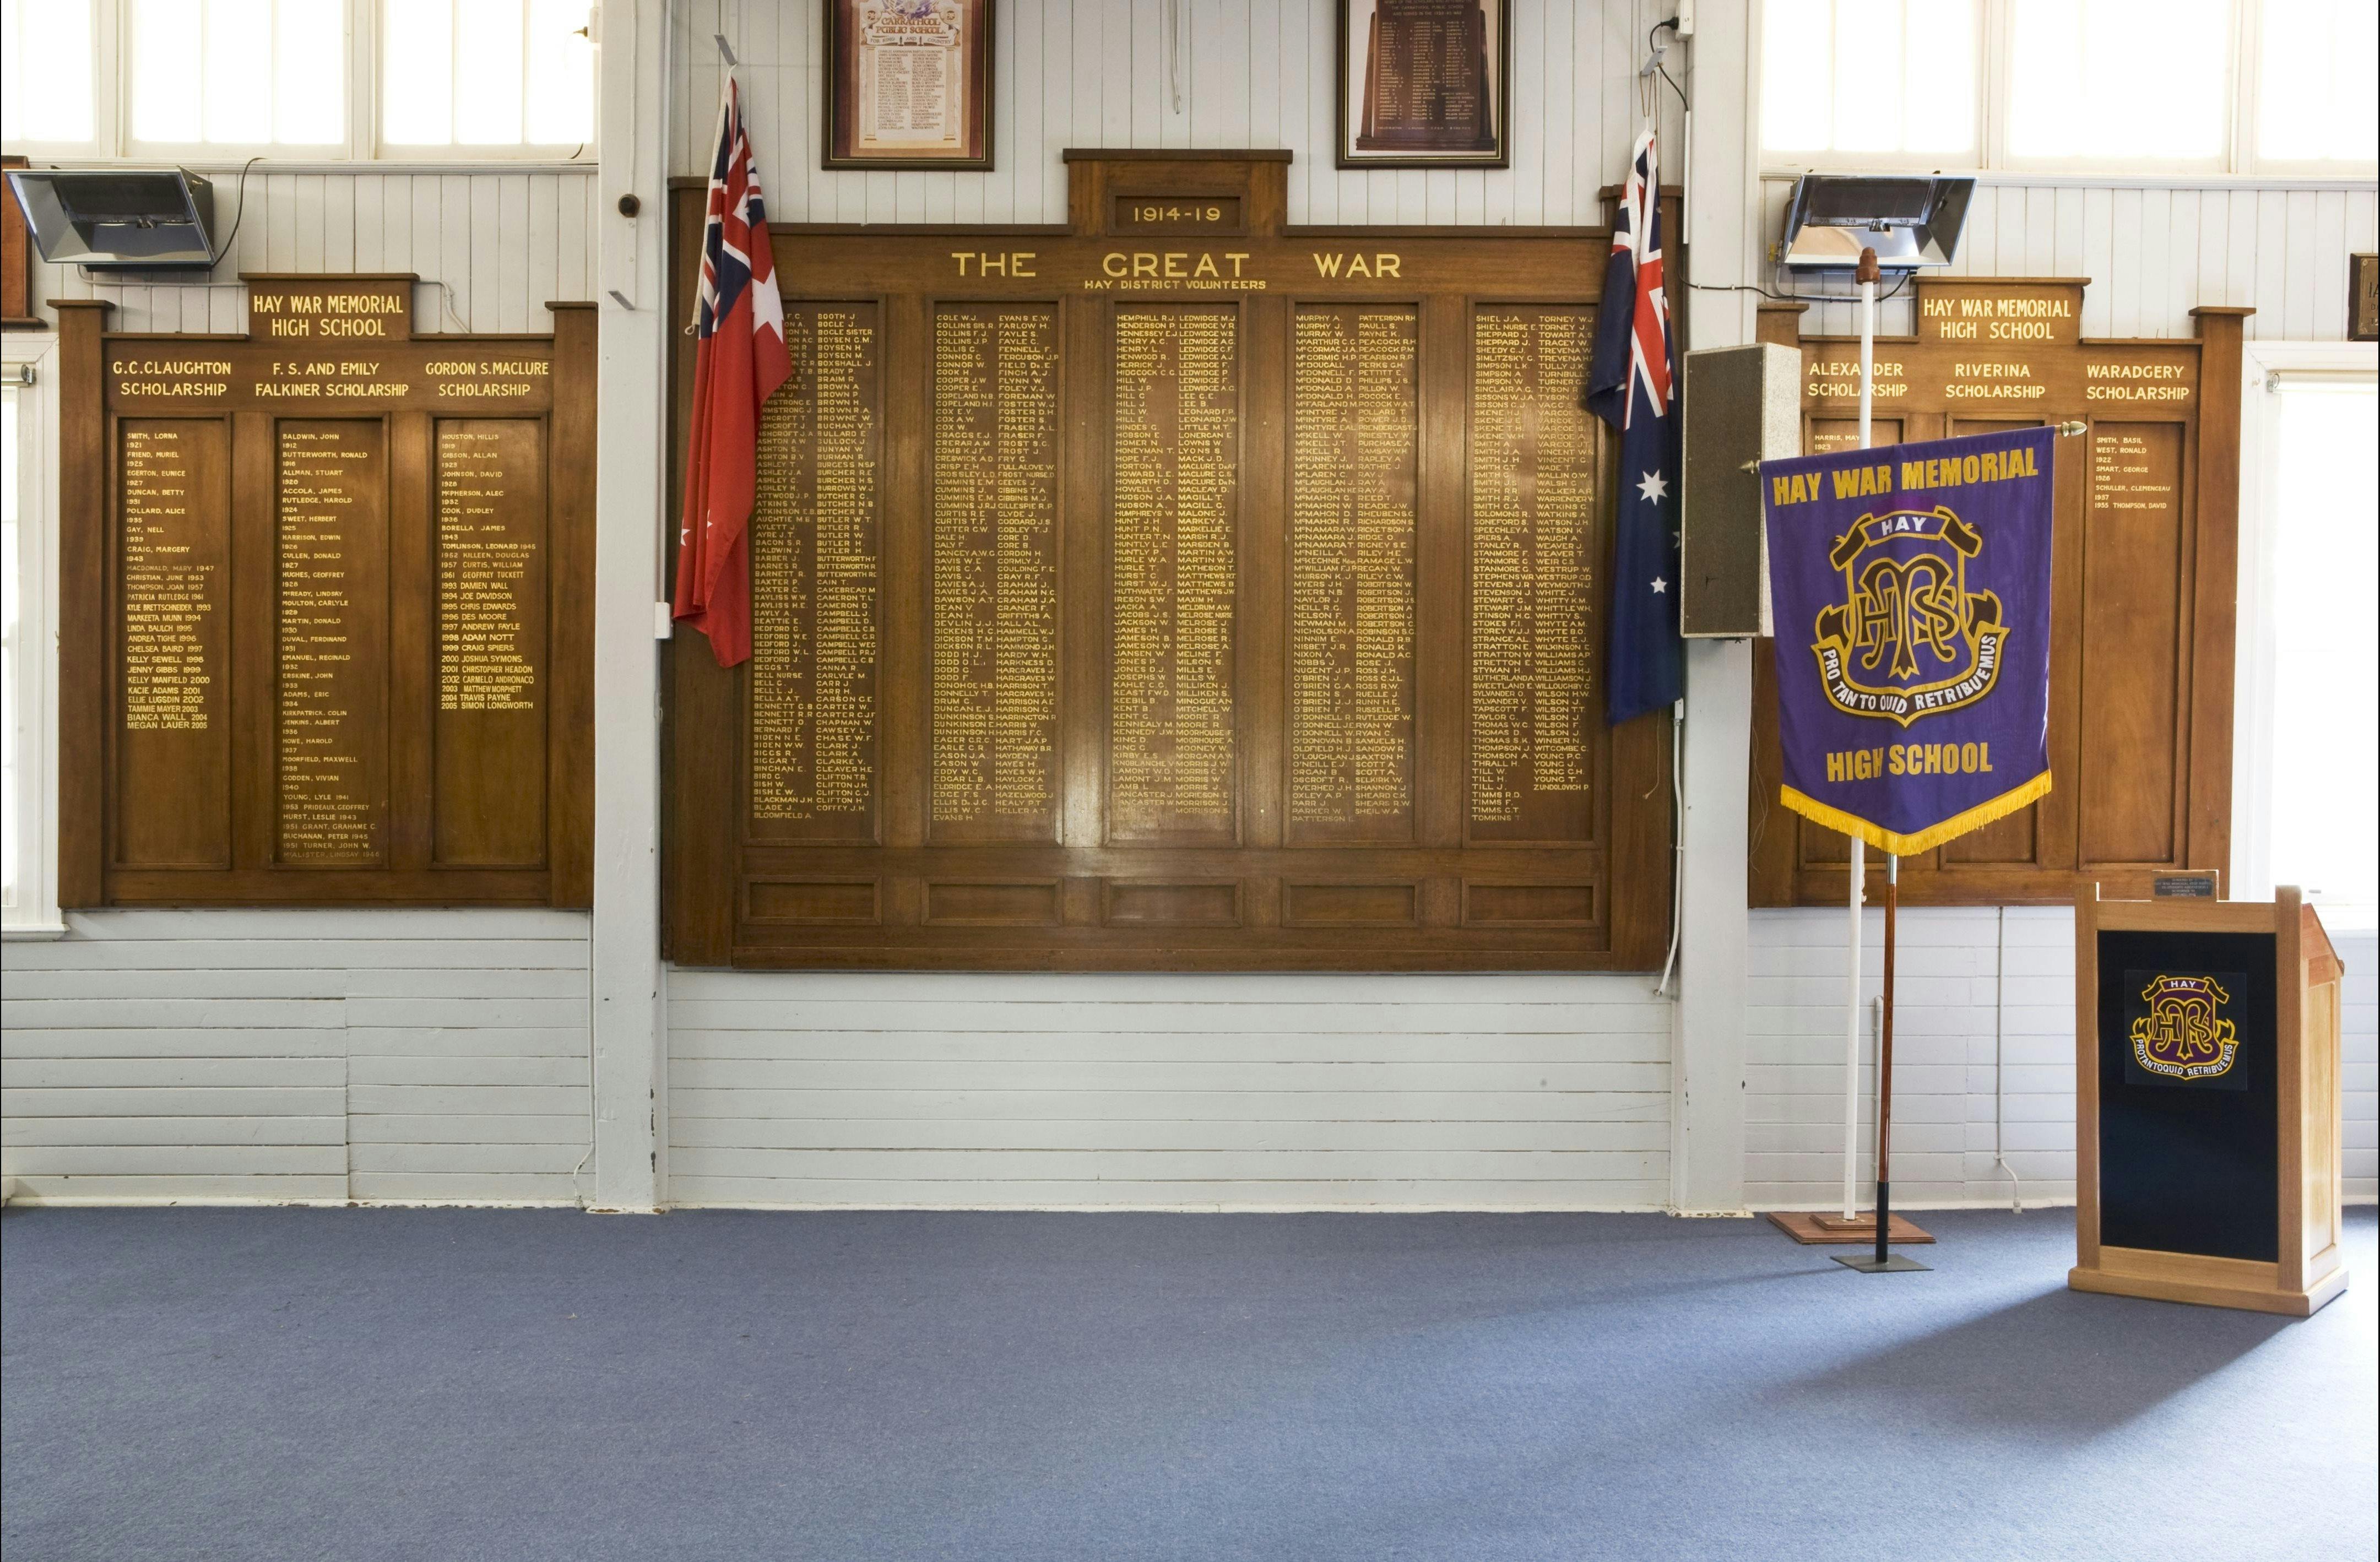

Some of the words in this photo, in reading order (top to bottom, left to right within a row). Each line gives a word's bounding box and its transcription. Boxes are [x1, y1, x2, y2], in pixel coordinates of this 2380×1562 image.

[1135, 207, 1221, 221] 1914-19
[952, 253, 1036, 277] THE
[1103, 253, 1250, 278] GREAT
[1313, 253, 1401, 278] WAR
[1085, 280, 1113, 289] HAY
[1120, 280, 1180, 289] DISTRICT
[1185, 280, 1266, 290] VOLUNTEERS
[254, 295, 284, 313] HAY
[290, 296, 322, 314] WAR
[327, 295, 403, 313] MEMORIAL
[1924, 299, 1955, 317] HAY
[1961, 299, 1993, 318] WAR
[1997, 299, 2071, 317] MEMORIAL
[272, 318, 309, 337] HIGH
[319, 318, 386, 337] SCHOOL
[1940, 321, 1977, 339] HIGH
[1989, 322, 2054, 340] SCHOOL
[273, 362, 284, 375] F.
[288, 362, 301, 375] S.
[305, 362, 335, 375] AND
[340, 362, 380, 376] EMILY
[425, 362, 476, 376] GORDON
[1809, 362, 1904, 376] ALEXADER
[1955, 363, 2031, 377] RIVERINA
[2086, 365, 2184, 379] WARADGERY
[121, 382, 227, 396] SCHOLARSHIP
[256, 383, 321, 397] FALKINER
[326, 383, 409, 397] SCHOLARSHIP
[438, 383, 530, 397] SCHOLARSHIP
[1945, 384, 2046, 398] SCHOLARSHIP
[2086, 386, 2189, 400] SCHOLARSHIP
[1815, 443, 1831, 451] 1923
[1772, 472, 1822, 506] HAY
[1832, 465, 1892, 500] WAR
[1901, 447, 2039, 490] MEMORIAL
[1881, 516, 1927, 536] HAY
[460, 582, 487, 590] DAMIEN
[1823, 648, 1841, 680] PRO
[1915, 634, 1997, 711] RETRIBUEMUS
[128, 686, 150, 695] KACIE
[152, 686, 179, 695] ADAMS
[1826, 747, 1884, 782] HIGH
[1888, 742, 1993, 775] SCHOOL
[2187, 1044, 2233, 1076] RETRIBUEMUS
